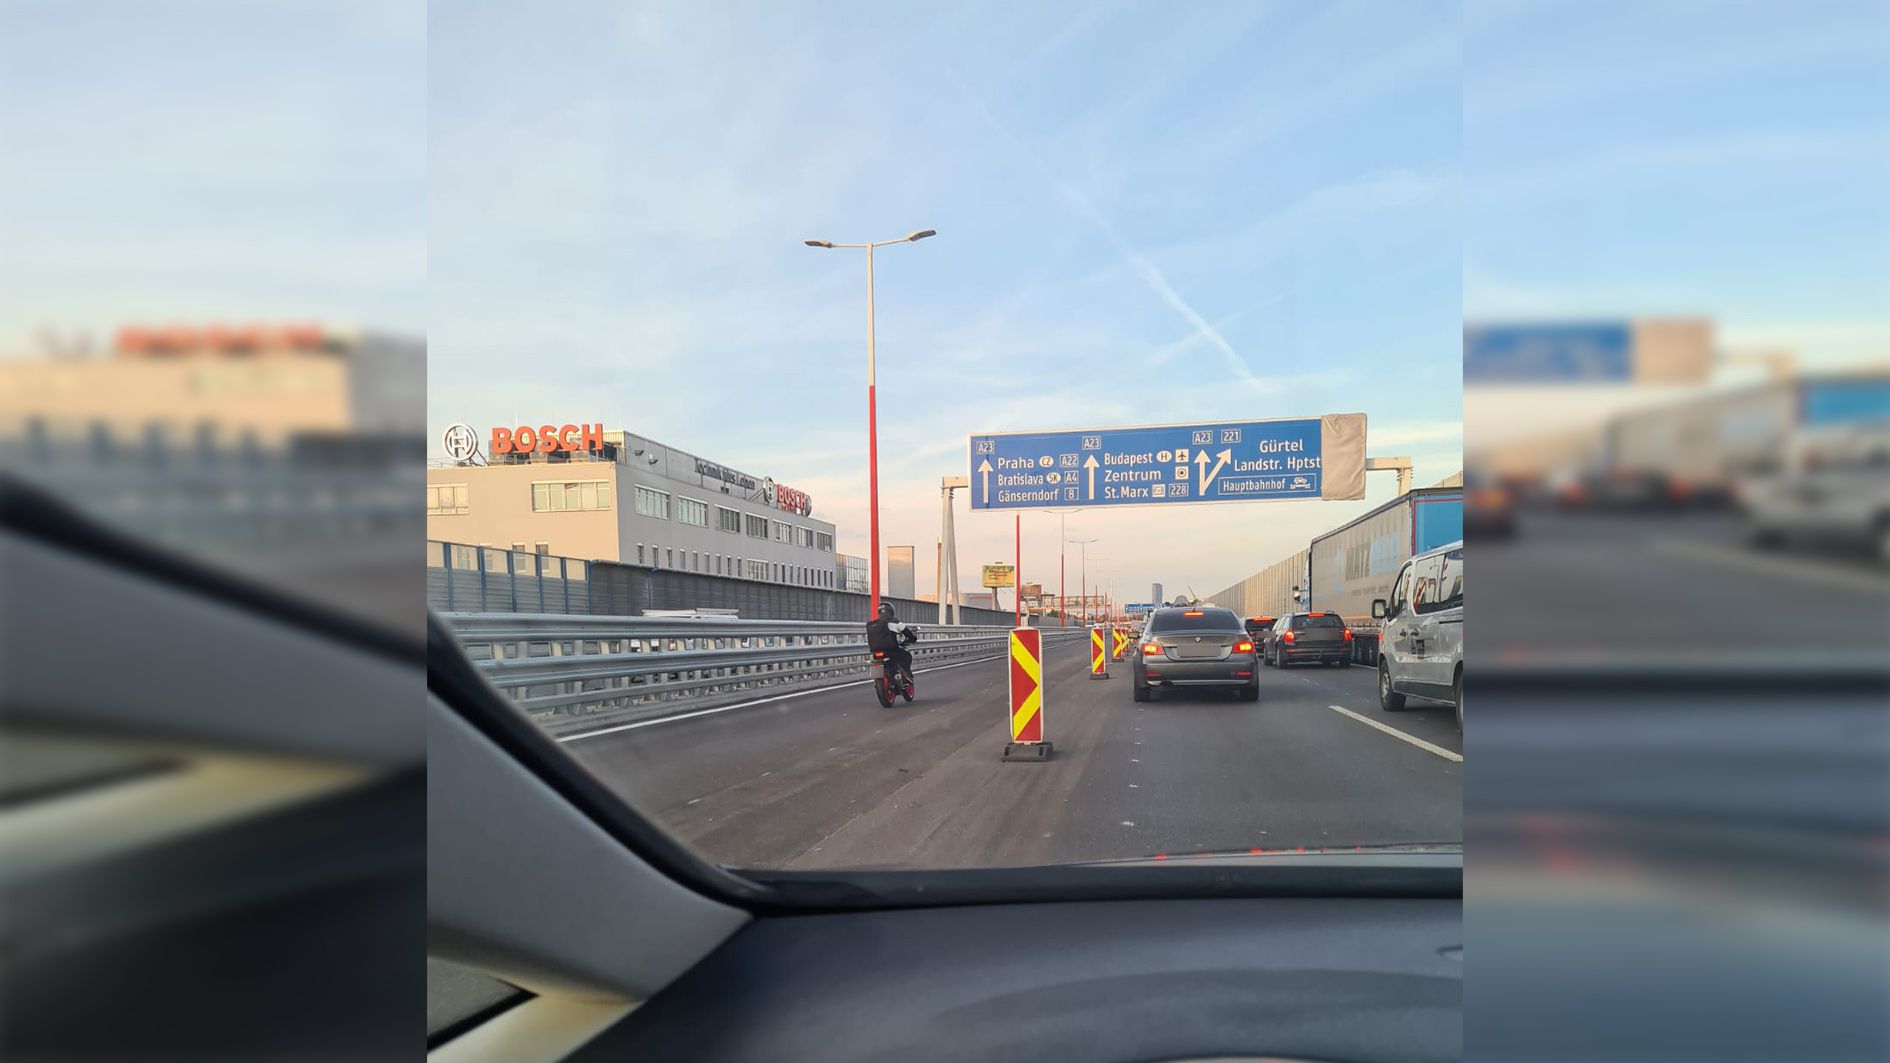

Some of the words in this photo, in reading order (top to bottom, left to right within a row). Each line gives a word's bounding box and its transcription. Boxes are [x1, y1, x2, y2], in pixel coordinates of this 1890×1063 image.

[491, 422, 603, 454] BOSCH
[1084, 438, 1100, 448] A23
[1195, 433, 1211, 443] A23
[1223, 431, 1239, 442] 221
[978, 443, 993, 453] A23
[1260, 438, 1303, 453] Gürtel
[998, 457, 1034, 469] Praha
[1061, 455, 1077, 466] A22
[1104, 452, 1153, 467] Budapest
[1235, 459, 1283, 472] Landstr.
[998, 472, 1044, 486] Bratislava
[1066, 472, 1077, 482] A4
[1105, 470, 1162, 482] Zentrum
[1171, 485, 1187, 495] 228
[1223, 478, 1286, 493] Hauptbahnhof
[777, 484, 807, 509] BOSCH
[998, 489, 1059, 502] Gänserndorf
[1068, 489, 1074, 499] 8
